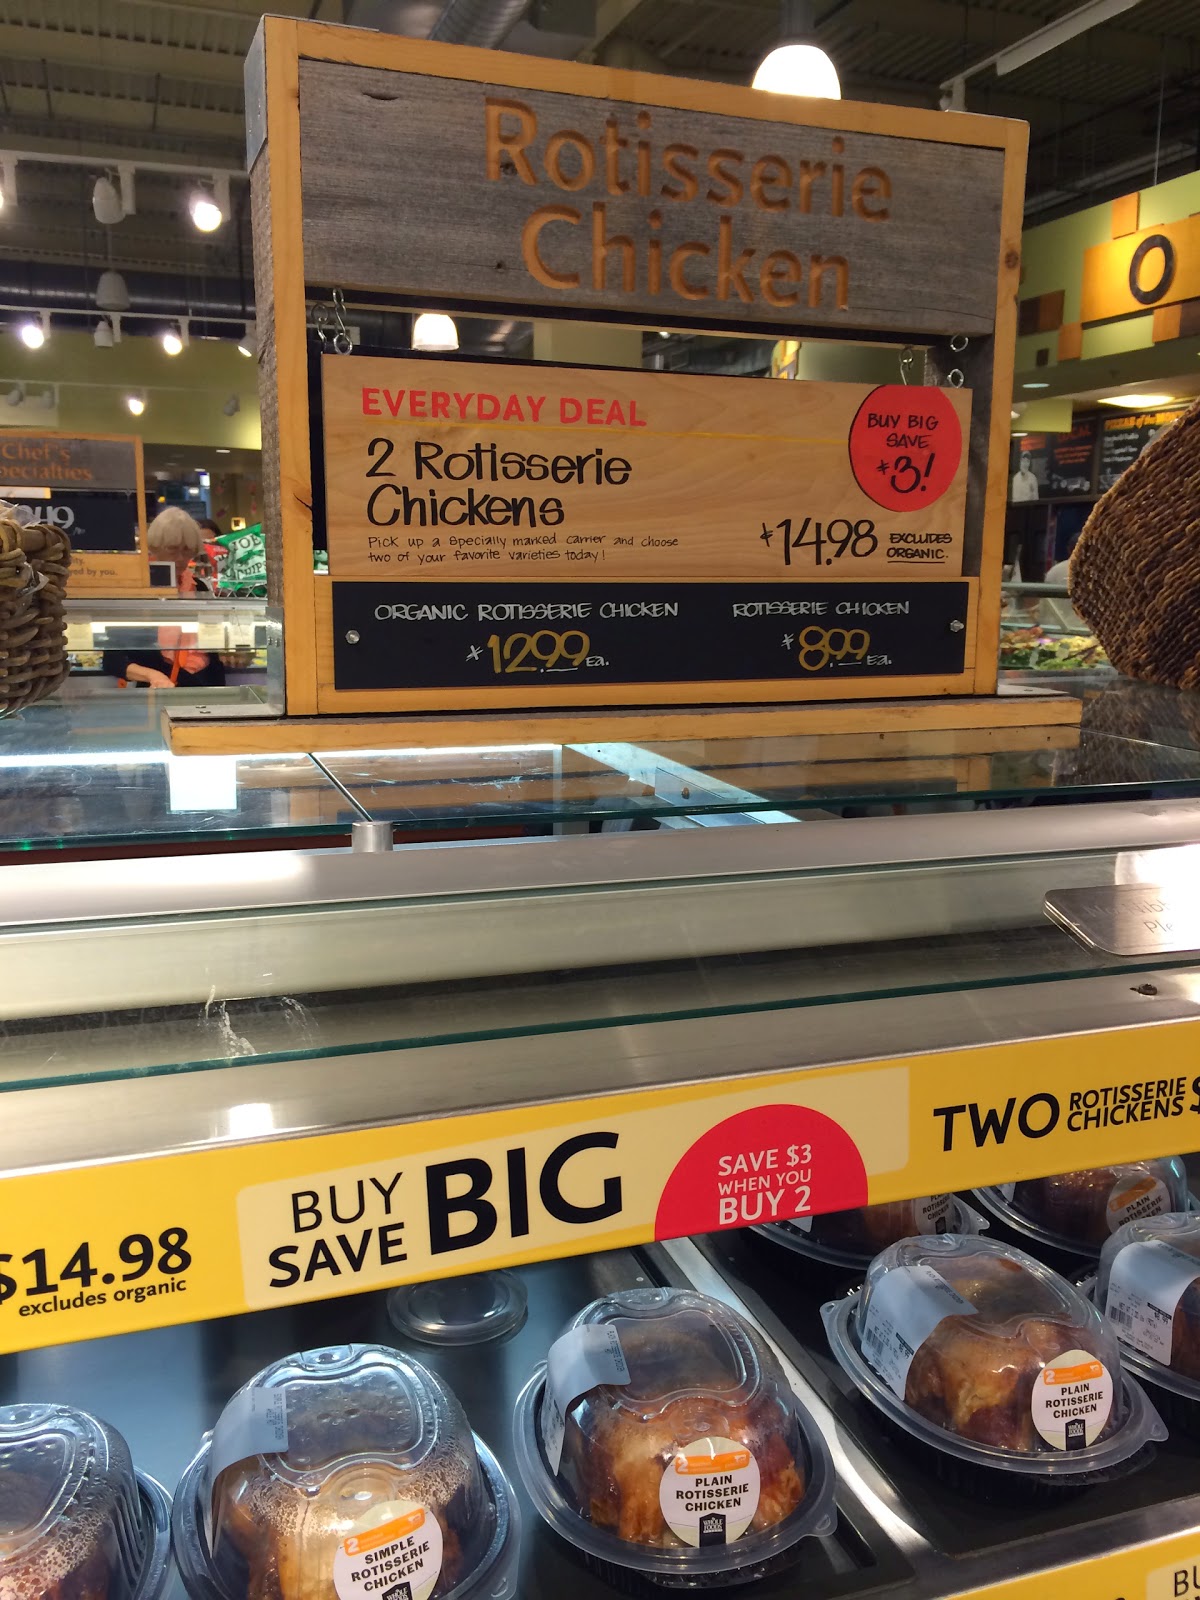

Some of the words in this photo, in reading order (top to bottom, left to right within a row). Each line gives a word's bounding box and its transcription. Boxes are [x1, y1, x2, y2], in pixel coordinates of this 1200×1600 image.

[484, 97, 893, 223] Rotisserie
[520, 200, 850, 309] Chicken
[362, 387, 547, 423] EVERYDAY
[559, 397, 647, 427] DEAL
[867, 413, 901, 429] BUY
[908, 415, 939, 430] BIG
[1, 441, 71, 460] Chef's
[886, 433, 932, 448] SAVE
[366, 437, 397, 478] 2
[414, 440, 632, 486] Rotisserie
[876, 453, 936, 494] $3!
[366, 483, 565, 528] Chickens
[368, 536, 399, 549] Pick
[408, 538, 424, 550] up
[432, 538, 441, 548] a
[512, 534, 557, 547] marked
[566, 535, 607, 546] carrier
[613, 536, 634, 547] and
[641, 536, 679, 548] choose
[368, 551, 391, 563] two
[397, 550, 410, 562] of
[417, 552, 446, 565] your
[453, 549, 501, 561] favorite
[508, 548, 561, 561] varieties
[759, 517, 879, 566] $14.98
[889, 533, 953, 545] EXCLUDES
[886, 547, 949, 560] ORGANIC.
[374, 603, 469, 621] ORGANIC
[477, 603, 593, 621] ROTISSERIE
[599, 601, 679, 618] CHICKEN
[732, 601, 828, 618] ROTISSERIE
[835, 600, 910, 616] CHICKEN
[933, 1092, 1061, 1152] TWO
[1068, 1076, 1187, 1111] ROTISSERIE
[1067, 1096, 1184, 1132] CHICKENS
[718, 1148, 779, 1177] SAVE
[786, 1144, 812, 1168] $3
[425, 1131, 623, 1256] BIG
[717, 1174, 771, 1196] WHEN
[776, 1168, 812, 1187] YOU
[291, 1171, 403, 1234] BUY
[719, 1188, 786, 1226] BUY
[794, 1185, 811, 1213] 2
[1126, 1195, 1150, 1213] PLAIN
[0, 1227, 192, 1306] $14.98
[268, 1221, 408, 1288] SAVE
[18, 1291, 107, 1317] excludes
[113, 1277, 187, 1303] organic
[1045, 1391, 1104, 1409] ROTISSERIE
[1061, 1383, 1090, 1395] PLAIN
[1053, 1403, 1097, 1419] CHICKEN
[676, 1483, 749, 1500] ROTISSERIE
[695, 1475, 733, 1487] PLAIN
[685, 1497, 742, 1512] CHICKEN
[350, 1541, 430, 1582] ROTISSERIE
[364, 1536, 416, 1564] SIMPLE
[363, 1558, 425, 1592] CHICKEN
